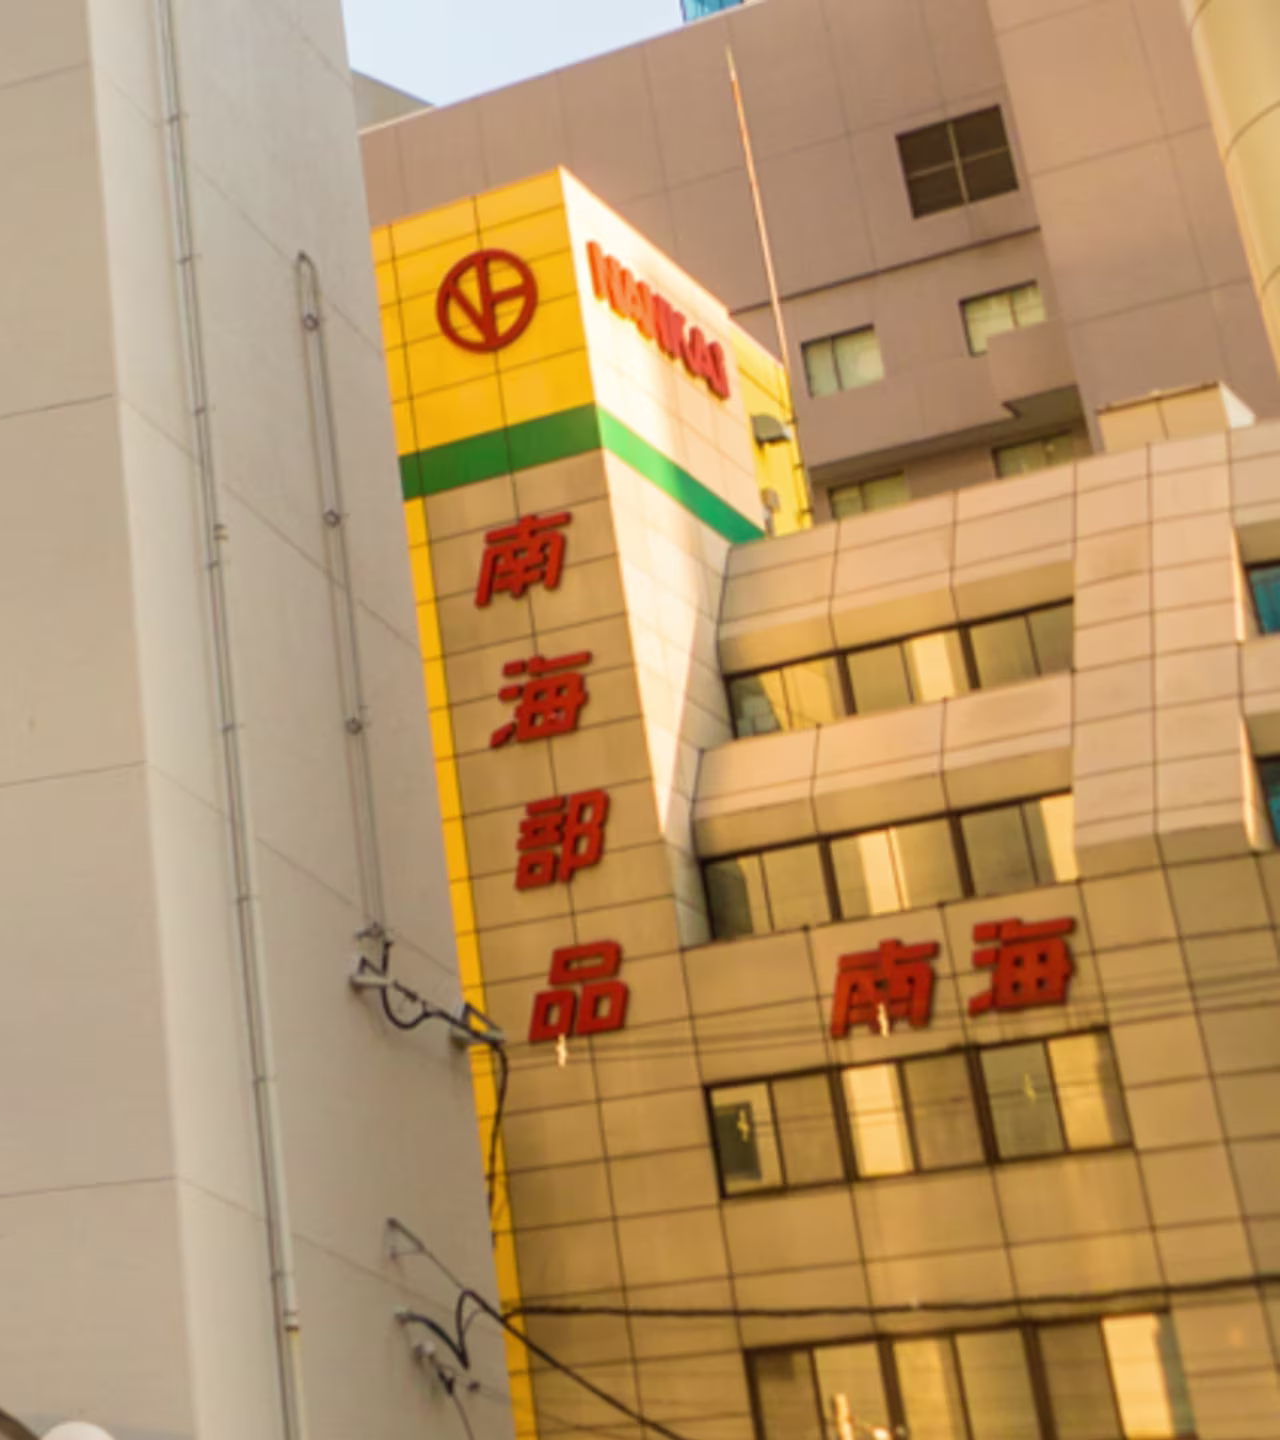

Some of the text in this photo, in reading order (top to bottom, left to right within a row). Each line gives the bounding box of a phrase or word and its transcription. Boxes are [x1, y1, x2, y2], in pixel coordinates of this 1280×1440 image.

[475, 511, 630, 1042] 南海部品
[830, 917, 1076, 1039] 南海
